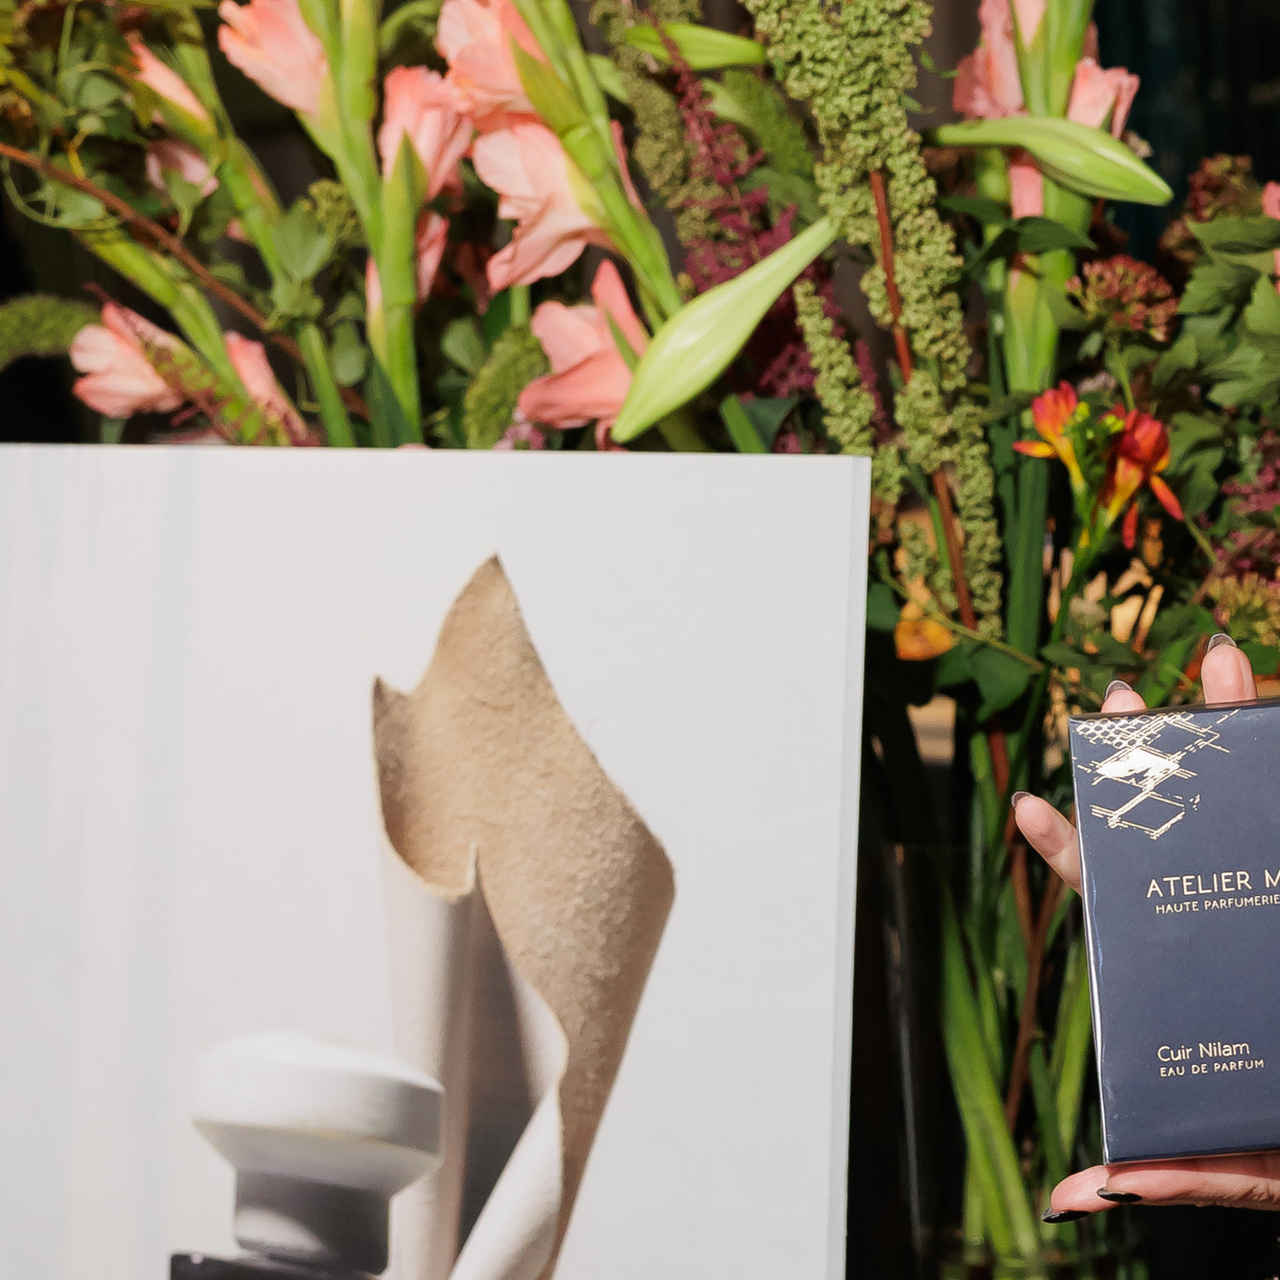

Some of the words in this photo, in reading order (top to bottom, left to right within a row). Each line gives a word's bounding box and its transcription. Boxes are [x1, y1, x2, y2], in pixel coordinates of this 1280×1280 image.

[1146, 870, 1253, 899] ATELIER
[1154, 901, 1200, 915] HAUTE
[1157, 1045, 1193, 1063] Cuir
[1198, 1041, 1251, 1059] Nilam
[1160, 1066, 1186, 1078] EAU
[1191, 1063, 1209, 1075] DE
[1213, 1059, 1265, 1072] PARFUM
